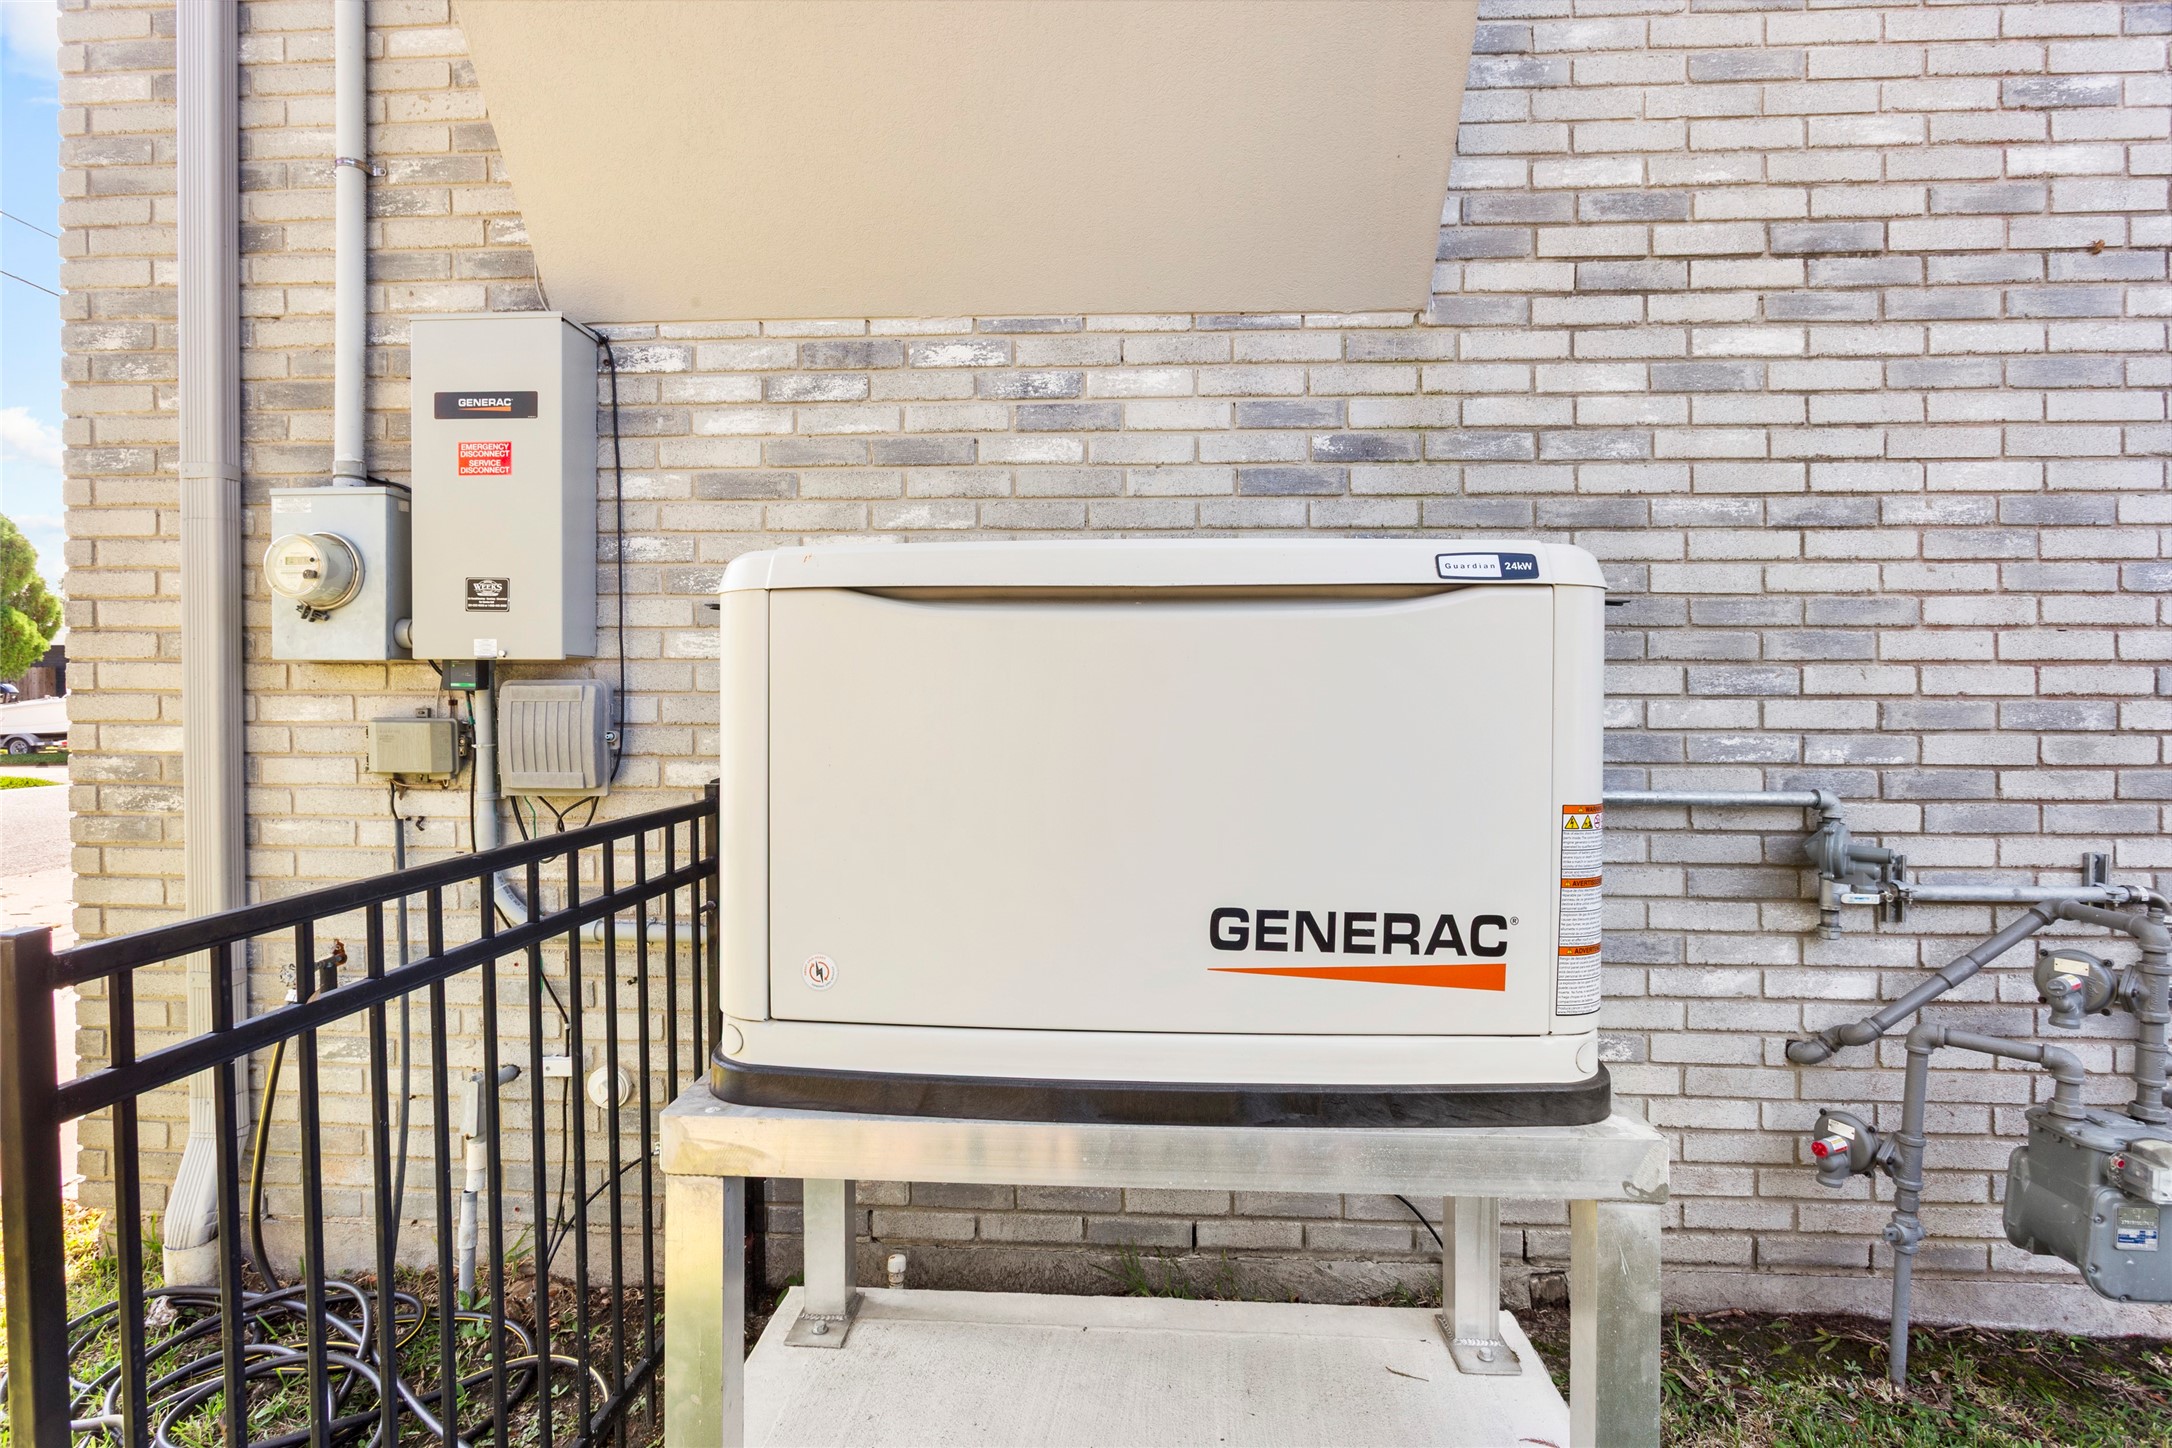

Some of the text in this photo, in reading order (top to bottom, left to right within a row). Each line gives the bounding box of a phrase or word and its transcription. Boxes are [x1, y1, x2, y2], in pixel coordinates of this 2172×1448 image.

[461, 443, 509, 451] EMERGENCY
[460, 450, 510, 458] DISCONNECT
[469, 459, 501, 467] SERVICE
[460, 466, 510, 474] DISCONNECT
[1444, 562, 1532, 571] Guardian 24kW
[473, 582, 502, 592] WEEKS
